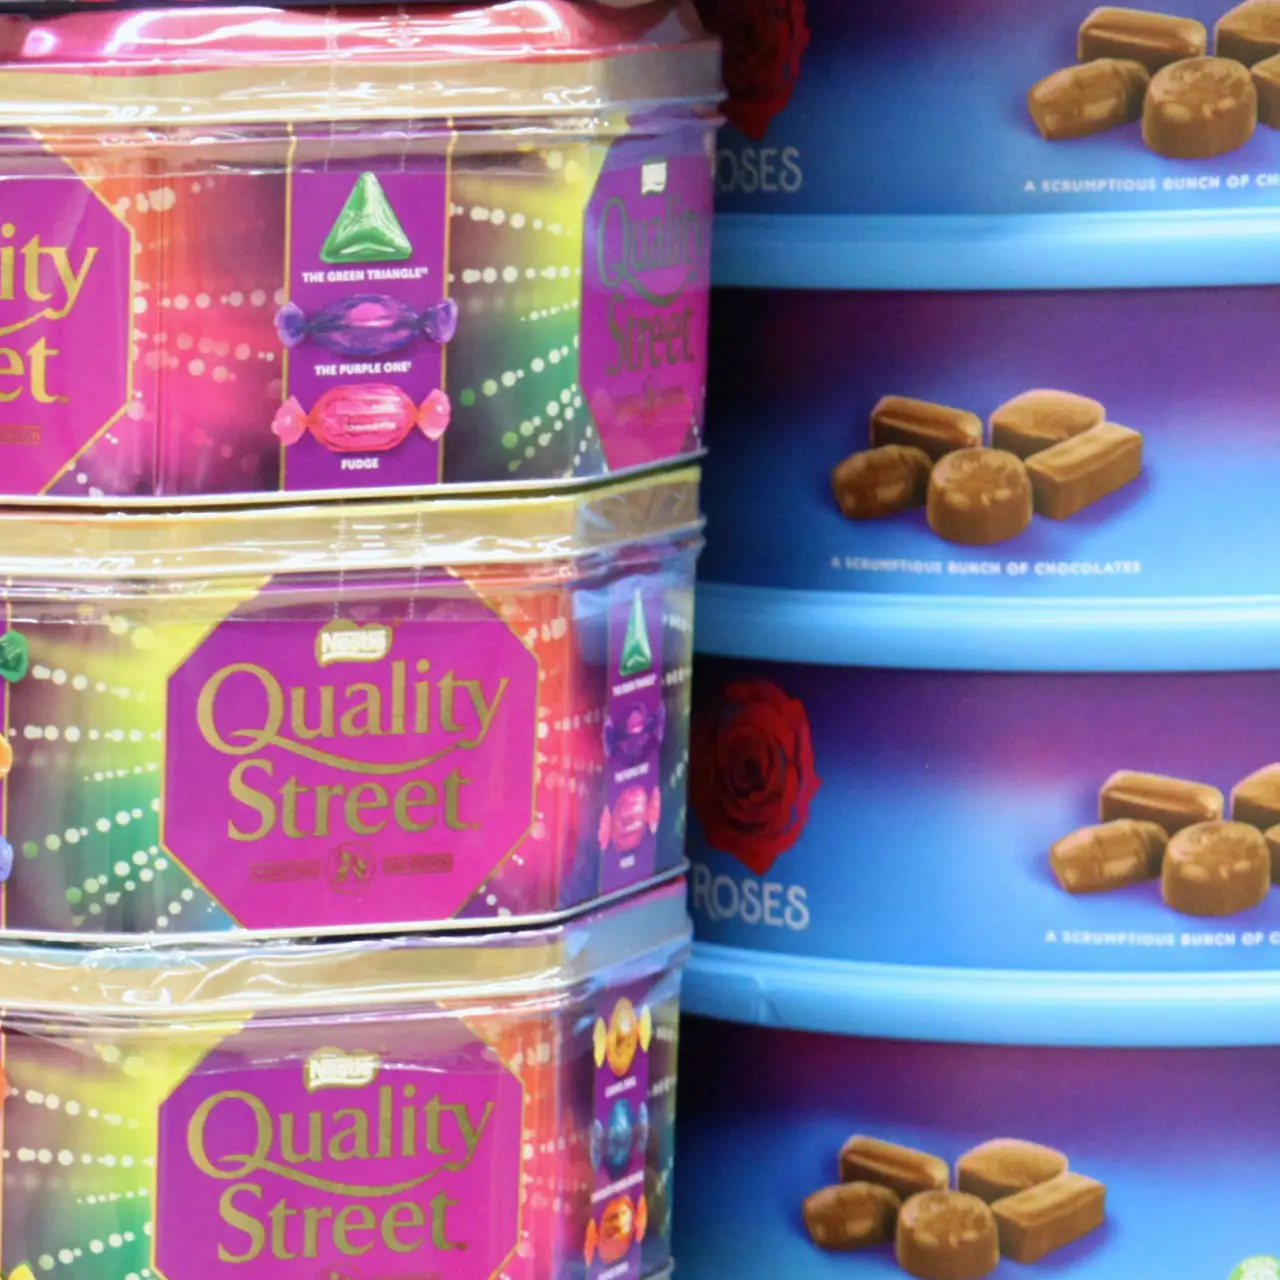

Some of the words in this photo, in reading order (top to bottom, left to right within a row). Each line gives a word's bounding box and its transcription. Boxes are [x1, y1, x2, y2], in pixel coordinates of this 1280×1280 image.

[718, 147, 803, 194] OSES
[302, 272, 325, 282] THE
[327, 270, 364, 282] GREEN
[315, 365, 337, 375] THE
[339, 363, 381, 374] PURPLE
[341, 458, 378, 469] FUDGE
[196, 661, 509, 774] Quality
[227, 762, 472, 842] Street
[694, 862, 810, 930] ROSES
[188, 1083, 495, 1196] Quality
[217, 1182, 458, 1263] Street
